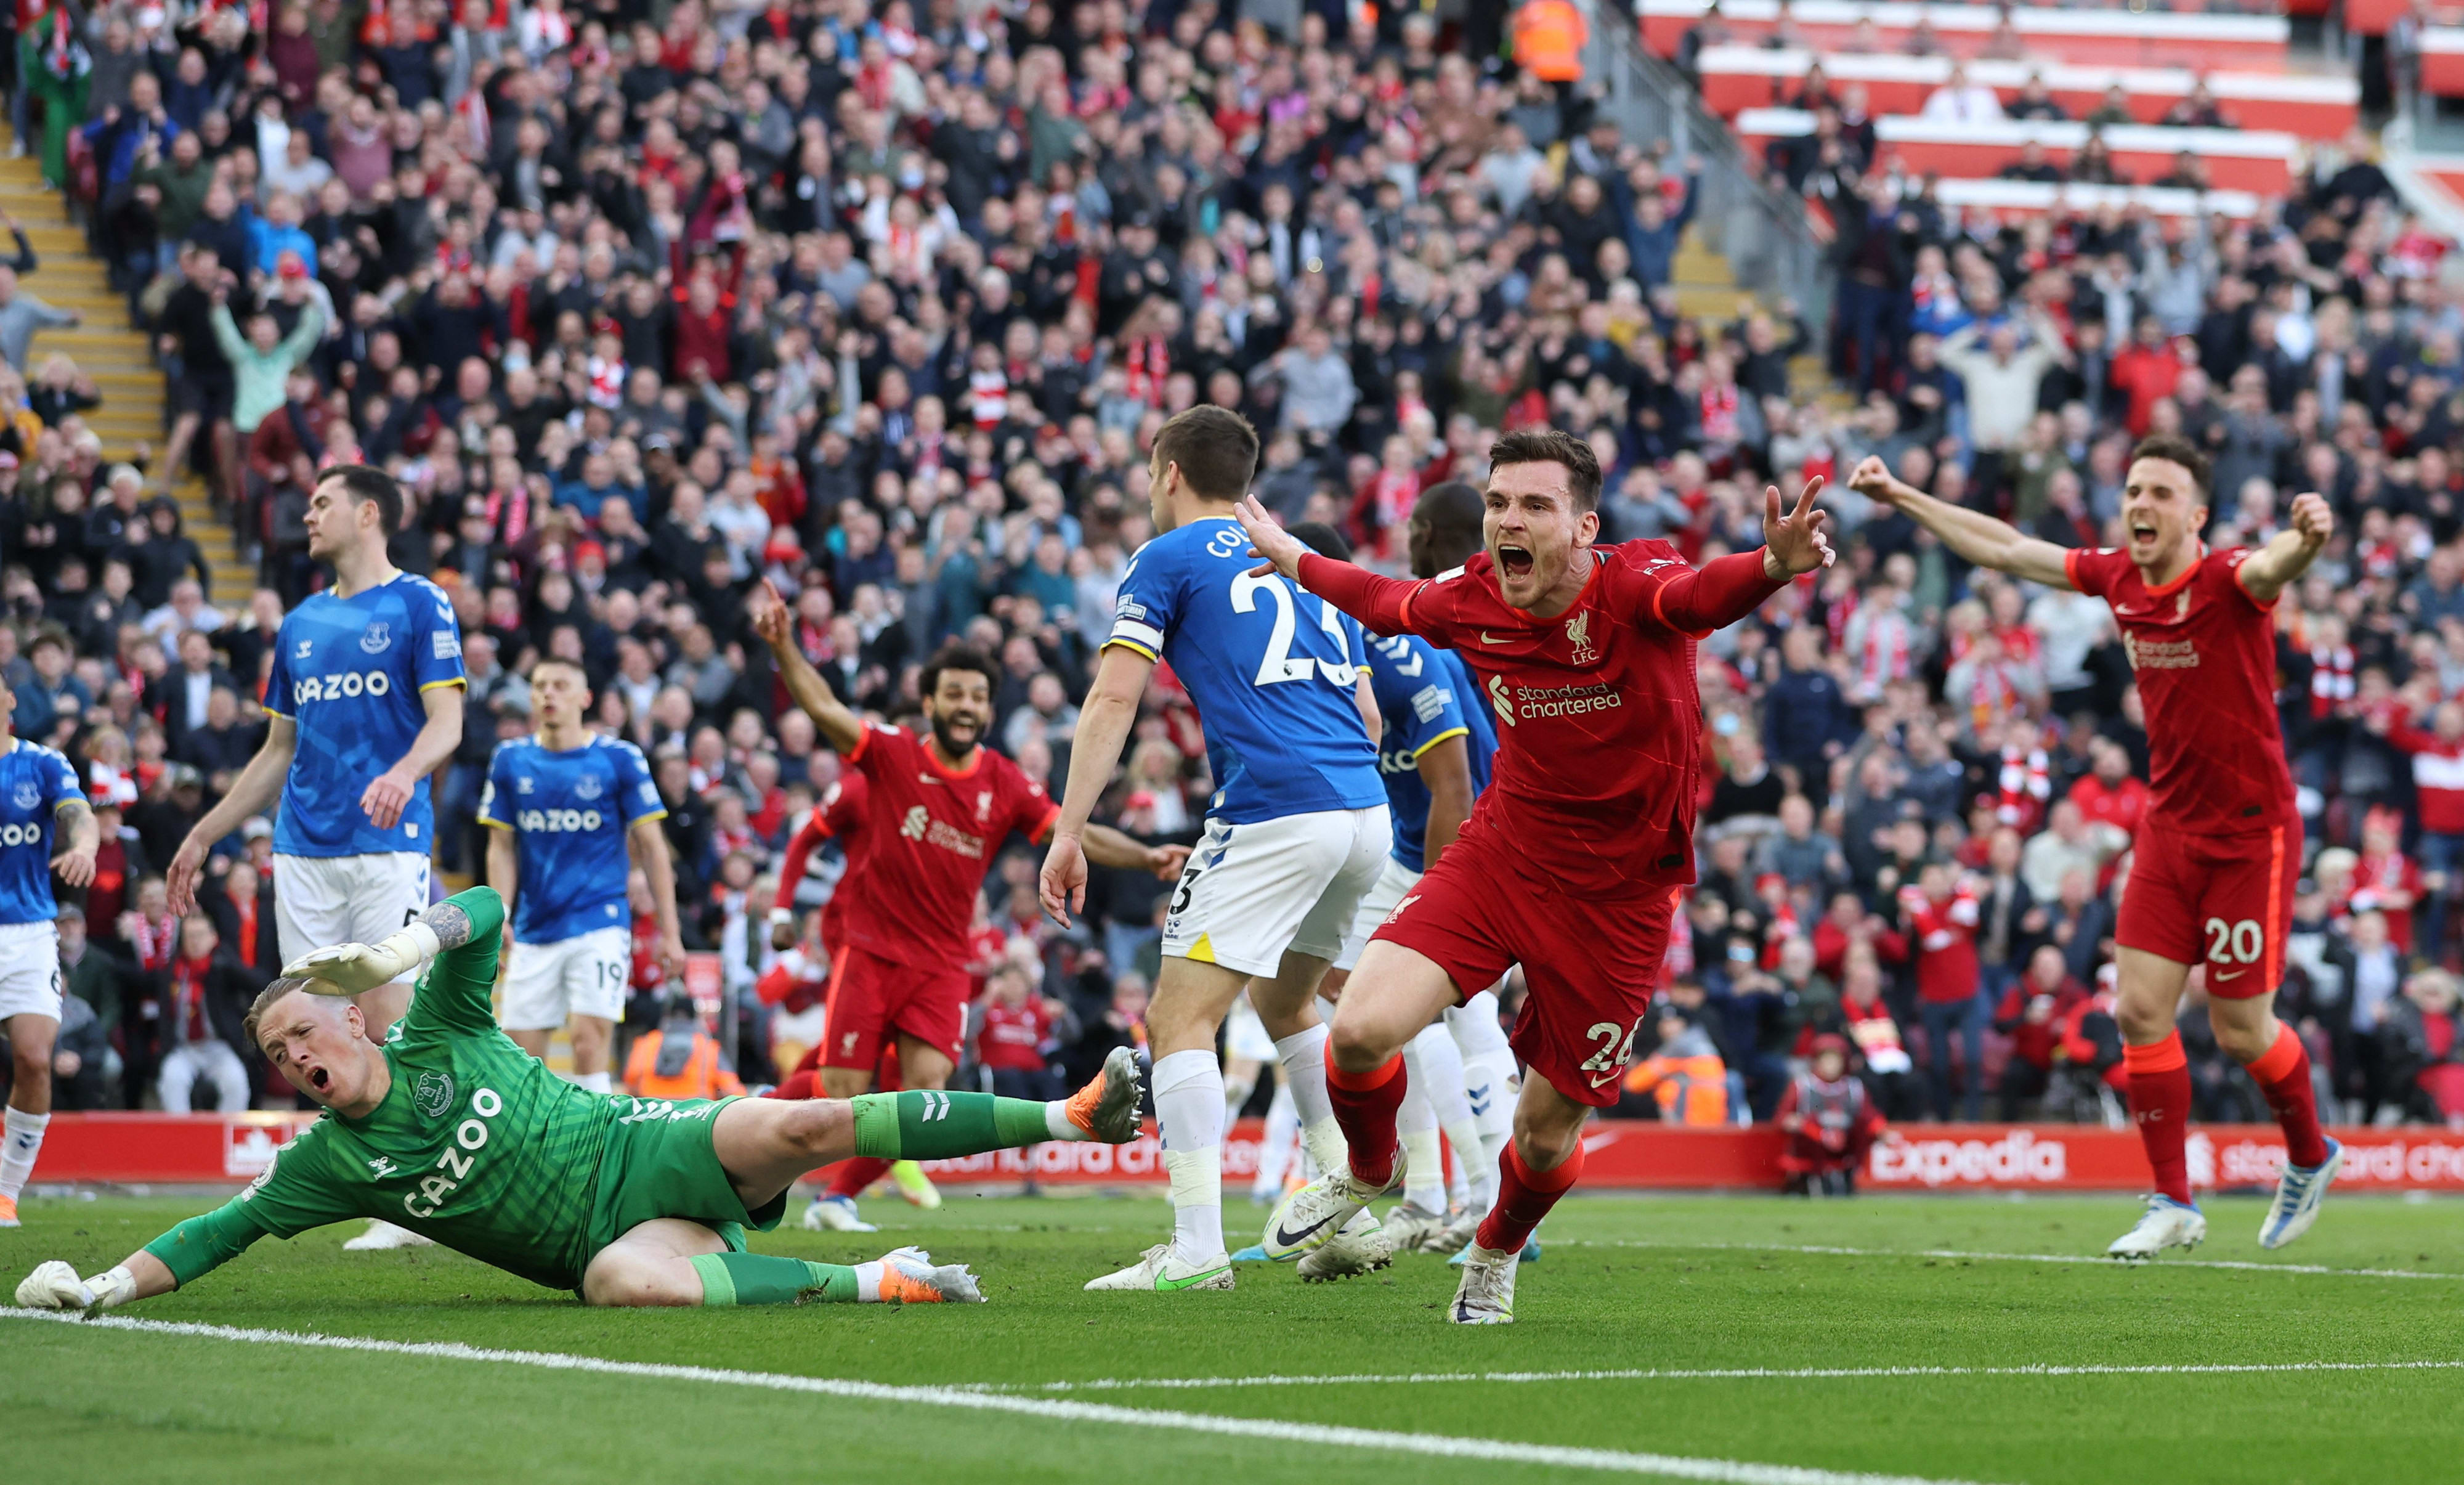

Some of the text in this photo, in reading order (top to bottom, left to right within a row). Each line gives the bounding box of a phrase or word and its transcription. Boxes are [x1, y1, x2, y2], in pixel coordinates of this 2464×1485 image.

[1206, 525, 1251, 558] COL
[1571, 649, 1600, 665] L.F.C.
[1517, 682, 1610, 702] standard
[1520, 691, 1622, 719] chartered
[2205, 916, 2263, 965] 20
[597, 959, 623, 991] 19
[1579, 1014, 1644, 1072] 26
[404, 1087, 503, 1218] CAZOO
[1870, 1130, 2067, 1187] Expedia
[2221, 1139, 2405, 1182] staard
